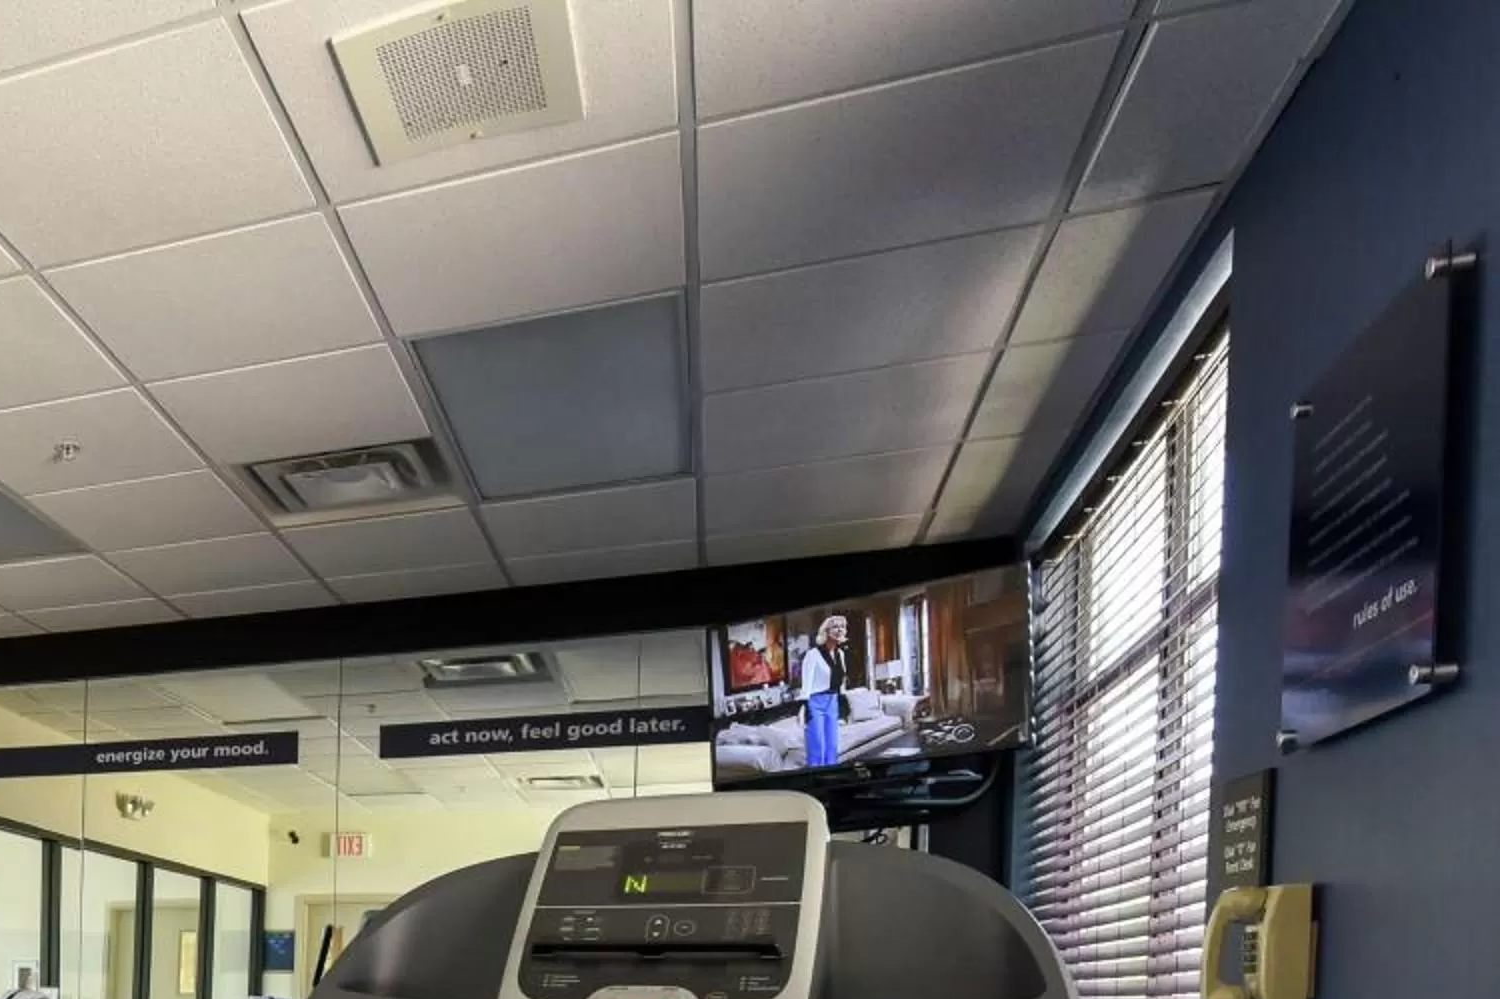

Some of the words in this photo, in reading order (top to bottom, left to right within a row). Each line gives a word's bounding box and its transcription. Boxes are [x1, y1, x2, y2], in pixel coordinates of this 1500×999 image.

[1353, 601, 1379, 630] rules
[1381, 584, 1393, 611] of
[429, 729, 459, 745] act
[465, 729, 514, 744] now,
[521, 722, 561, 740] feel
[567, 718, 622, 741] good
[629, 717, 686, 734] later.
[96, 747, 165, 765] energize
[170, 745, 209, 763] your
[213, 740, 269, 757] mood.
